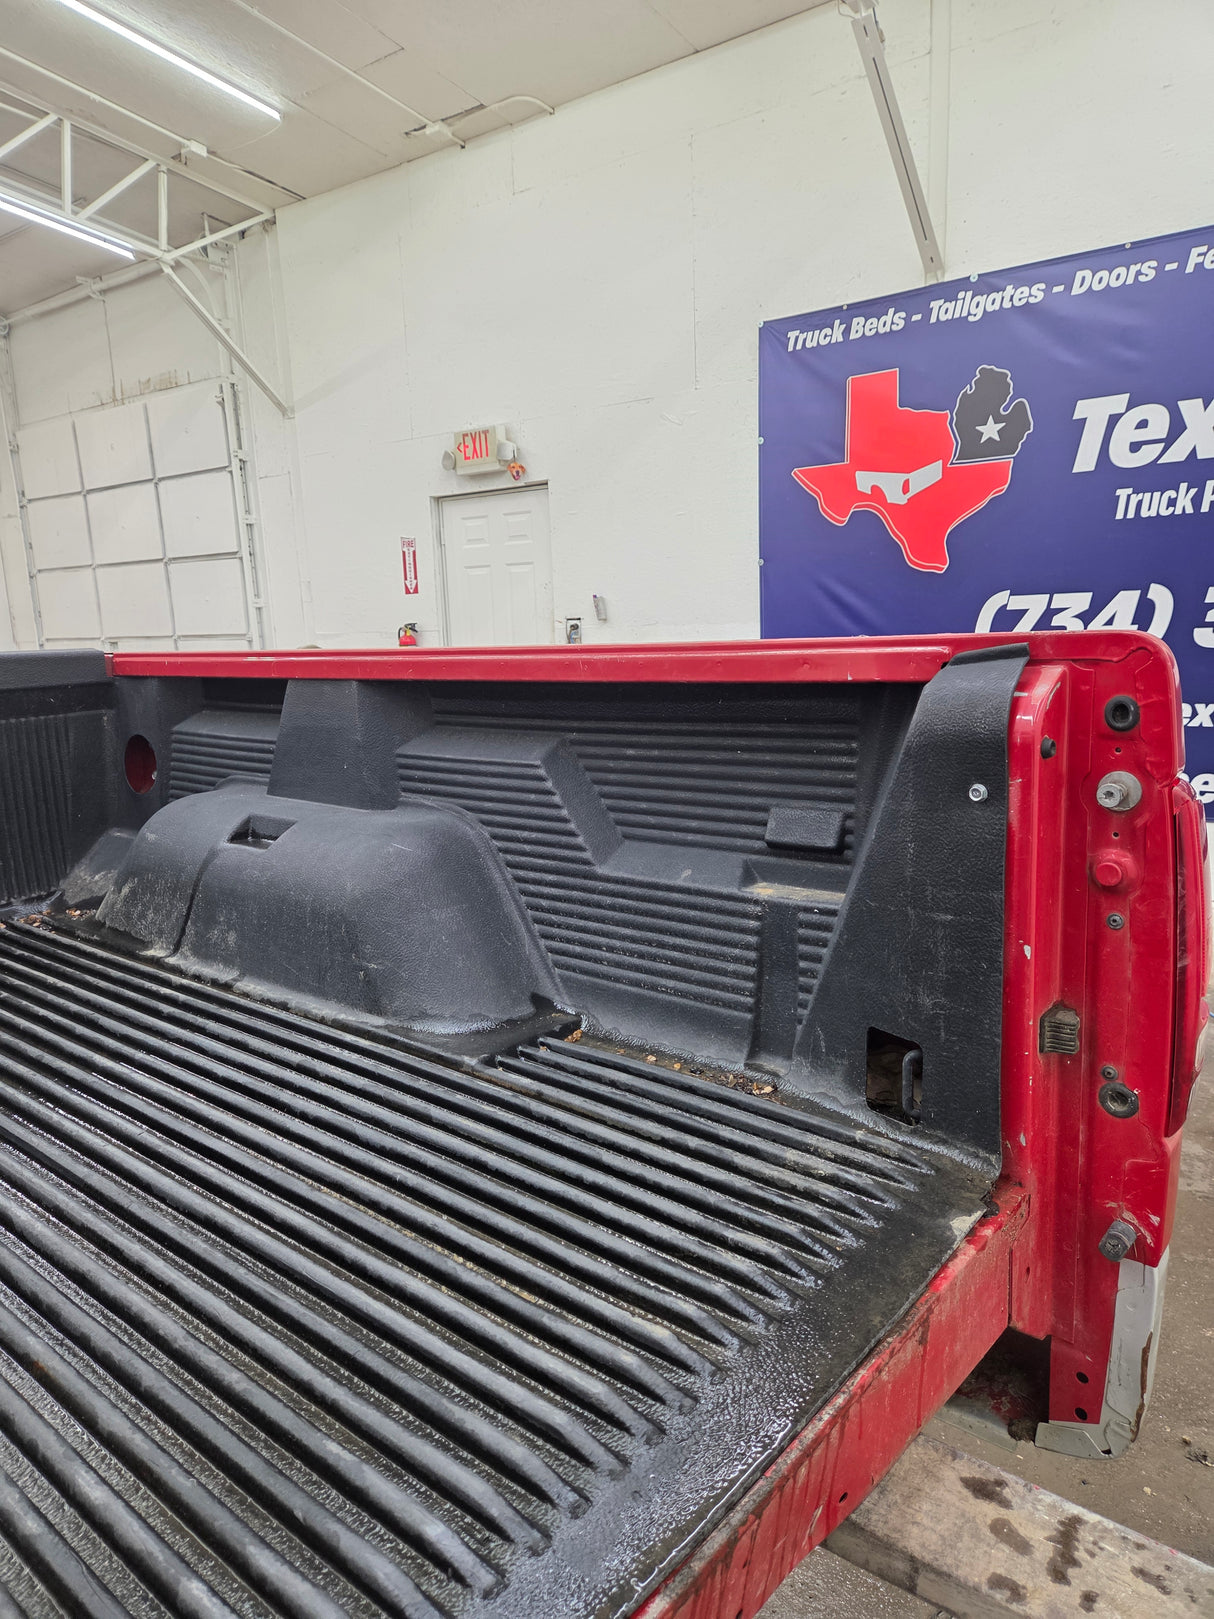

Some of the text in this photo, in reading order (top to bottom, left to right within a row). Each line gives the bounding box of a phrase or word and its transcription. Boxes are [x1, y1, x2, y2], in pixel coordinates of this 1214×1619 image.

[787, 319, 847, 352] Truck
[849, 308, 906, 340] Beds
[911, 313, 922, 322] -
[929, 283, 1046, 324] Tailgates
[1051, 284, 1065, 294] -
[1071, 260, 1158, 296] Doors
[1164, 261, 1179, 272] -
[462, 429, 489, 461] EXIT
[1071, 392, 1214, 474] Tex
[1114, 482, 1199, 520] Truck
[402, 540, 414, 548] FIRE
[975, 582, 1174, 640] (734)
